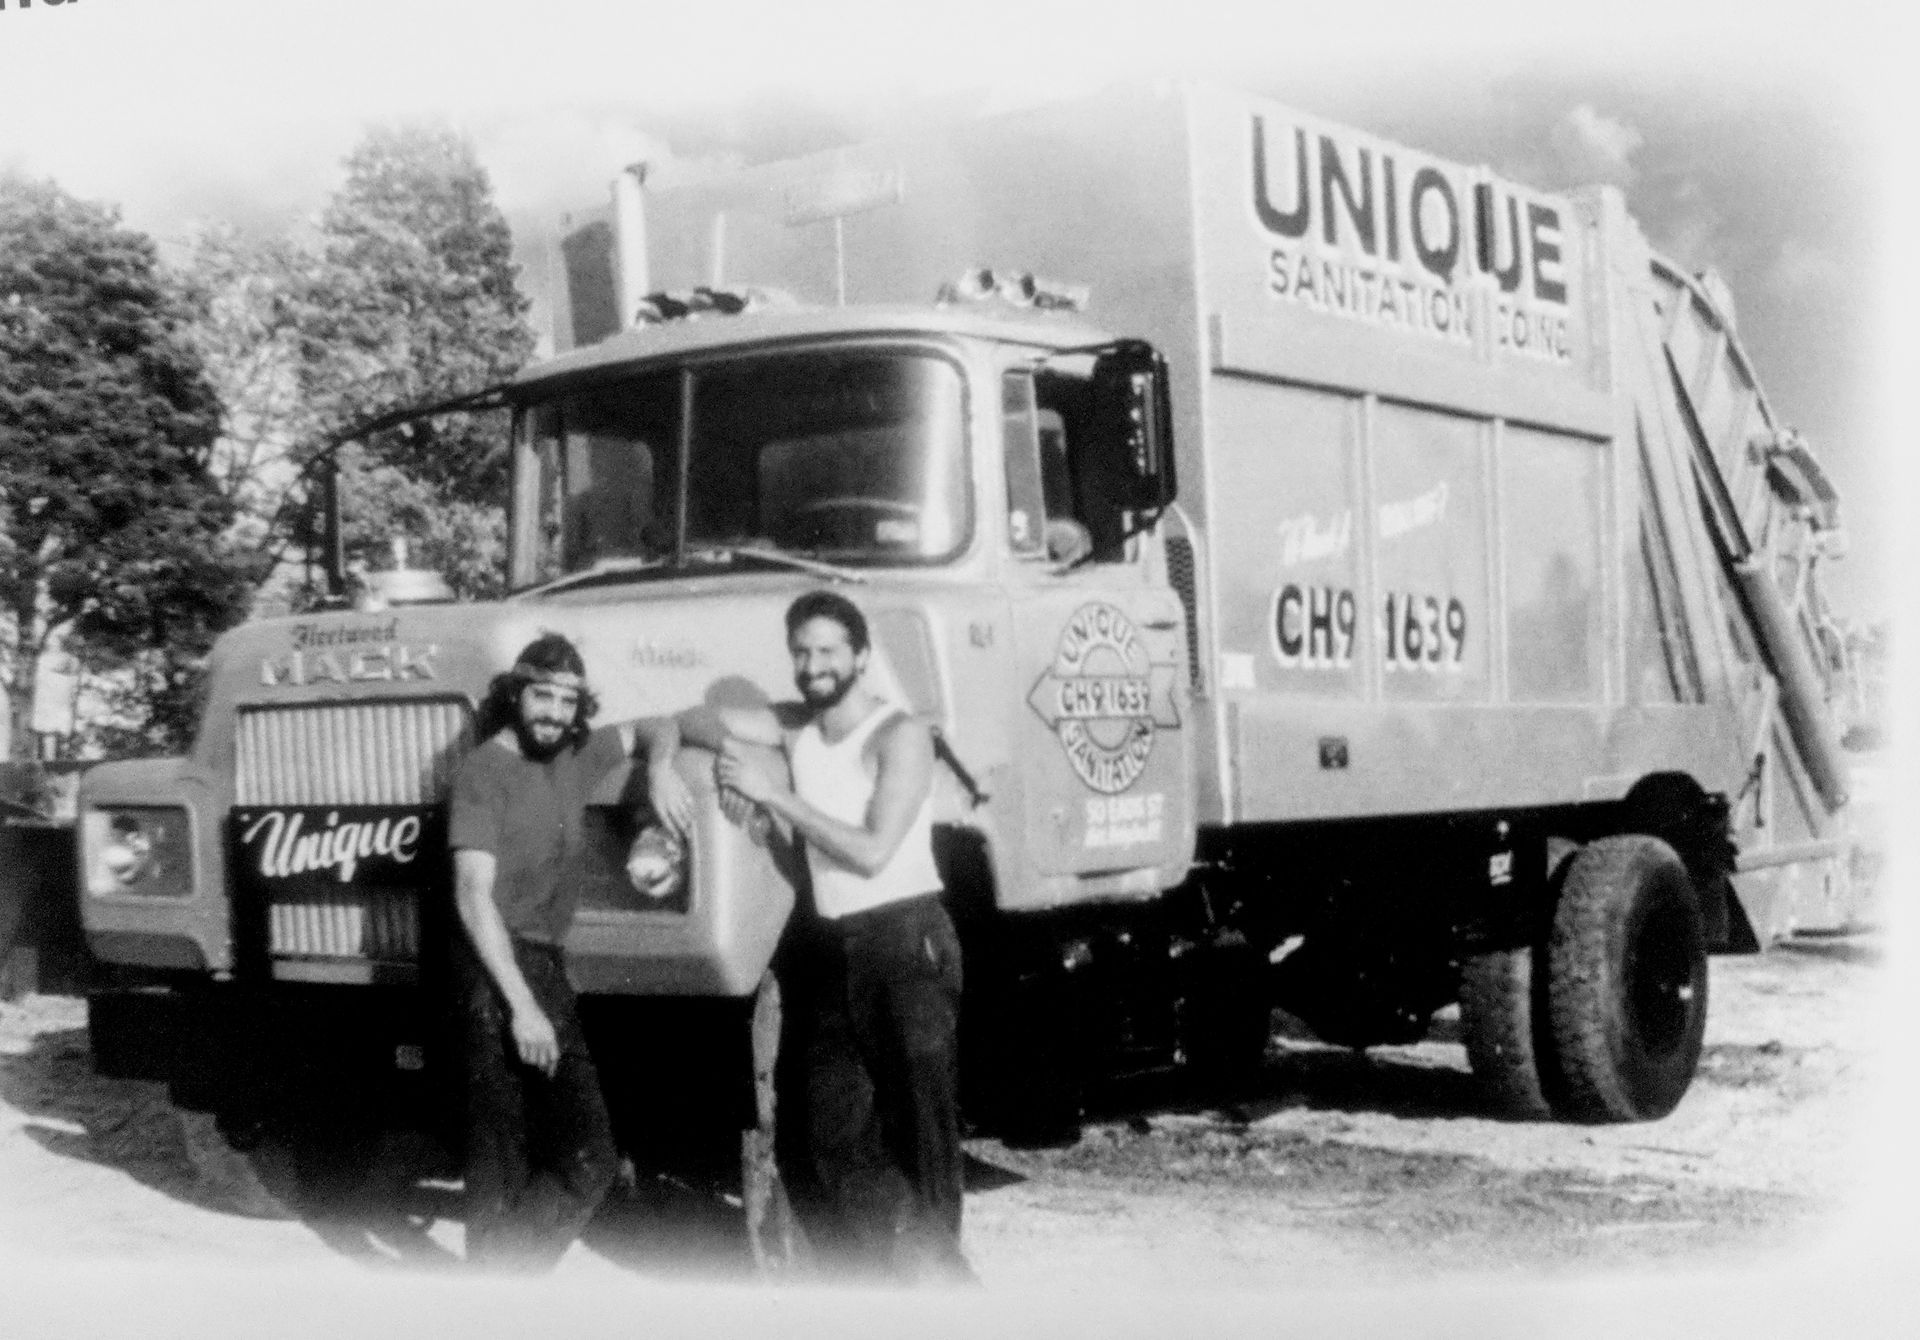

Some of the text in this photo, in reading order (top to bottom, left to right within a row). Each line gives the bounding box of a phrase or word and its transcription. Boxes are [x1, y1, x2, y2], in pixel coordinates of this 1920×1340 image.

[1251, 114, 1567, 305] UNIQUE
[1270, 248, 1474, 336] SANITATION
[1059, 606, 1142, 666] UNIQUE
[1275, 583, 1466, 663] CH9 1639
[259, 645, 435, 687] MACK
[241, 810, 421, 884] Unique
